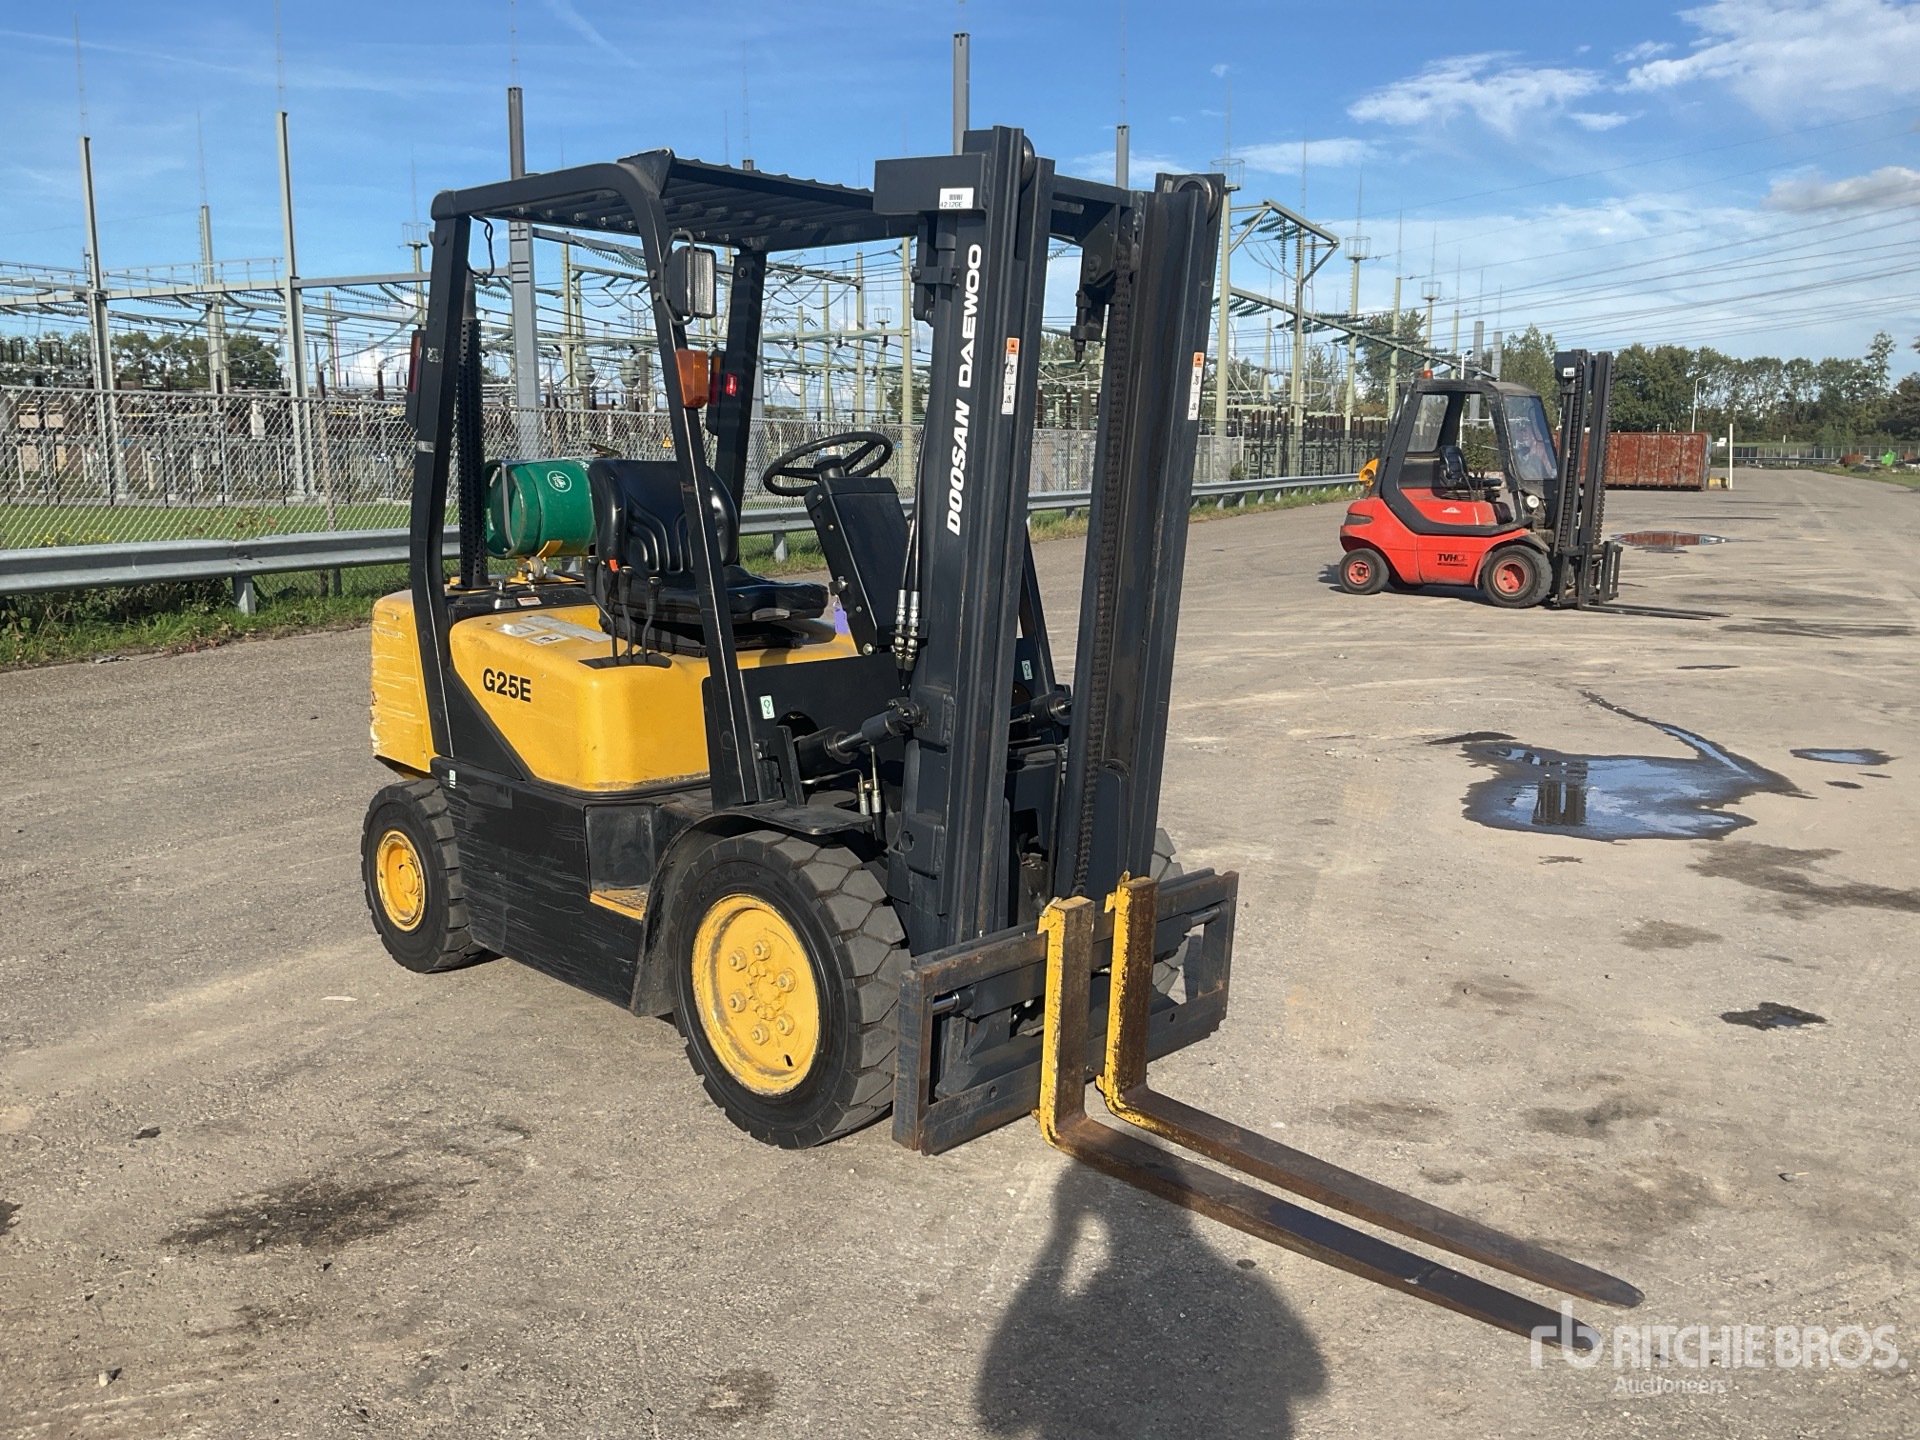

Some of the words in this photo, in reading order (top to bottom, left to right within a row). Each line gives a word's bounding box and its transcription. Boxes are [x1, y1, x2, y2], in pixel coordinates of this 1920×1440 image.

[946, 399, 970, 536] DOOSAN
[958, 243, 982, 388] DAEWOO
[483, 668, 531, 703] G25E
